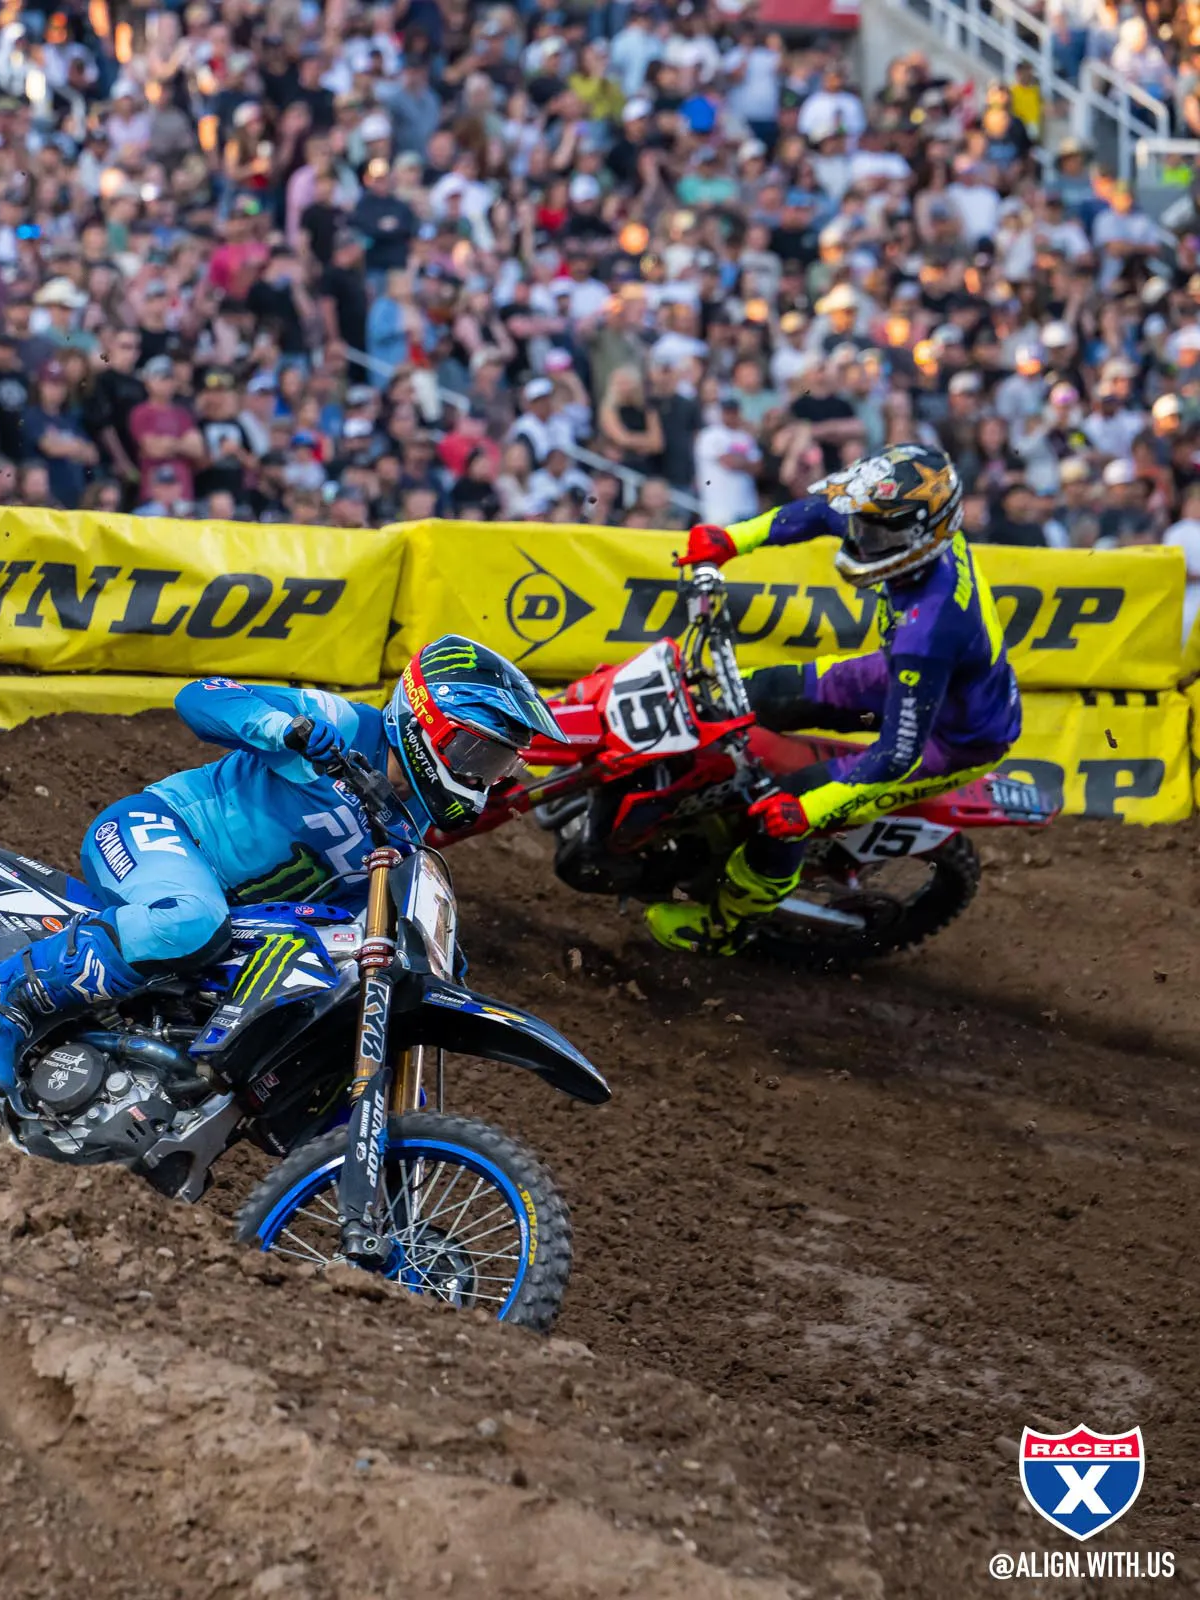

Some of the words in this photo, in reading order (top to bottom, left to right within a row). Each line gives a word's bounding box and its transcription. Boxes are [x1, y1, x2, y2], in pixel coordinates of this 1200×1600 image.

[516, 594, 561, 620] D
[605, 577, 1125, 651] DUNOP
[613, 670, 681, 744] 15
[405, 723, 438, 784] MONSTER
[16, 856, 53, 876] YAMAHA
[99, 833, 134, 881] YAMAHA
[858, 823, 924, 857] 15
[359, 979, 390, 1063] KYB
[359, 1099, 371, 1138] BRAKING
[520, 1190, 538, 1265] DUNLOP
